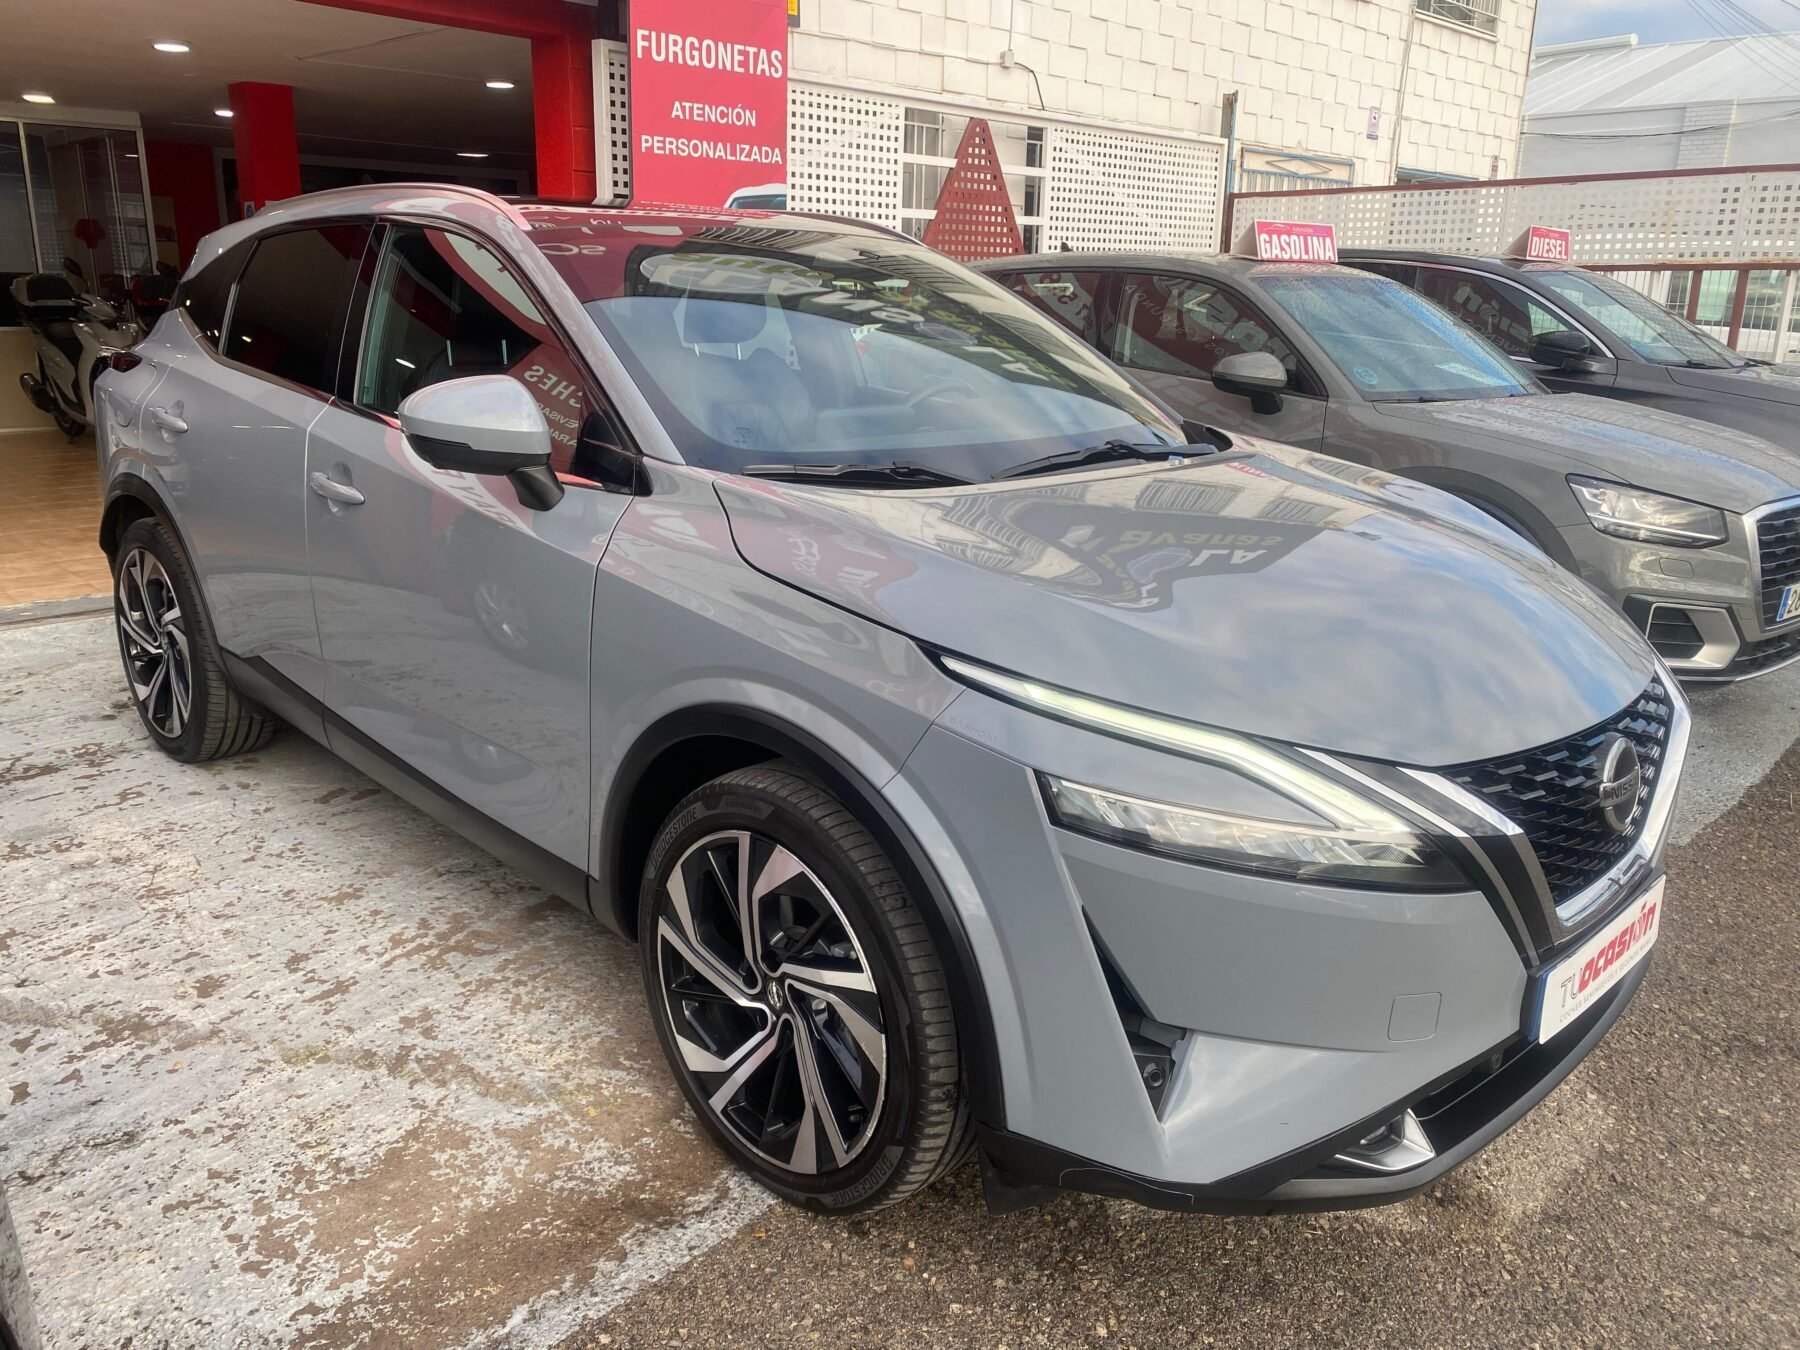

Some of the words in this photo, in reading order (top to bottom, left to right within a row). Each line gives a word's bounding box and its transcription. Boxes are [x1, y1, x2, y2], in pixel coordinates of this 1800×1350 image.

[636, 28, 783, 79] FURGONETAS
[671, 100, 756, 127] ATENCIÓN
[641, 134, 783, 165] PERSONALIZADA
[1260, 233, 1335, 261] GASOLINA
[1530, 236, 1568, 260] DIESEL
